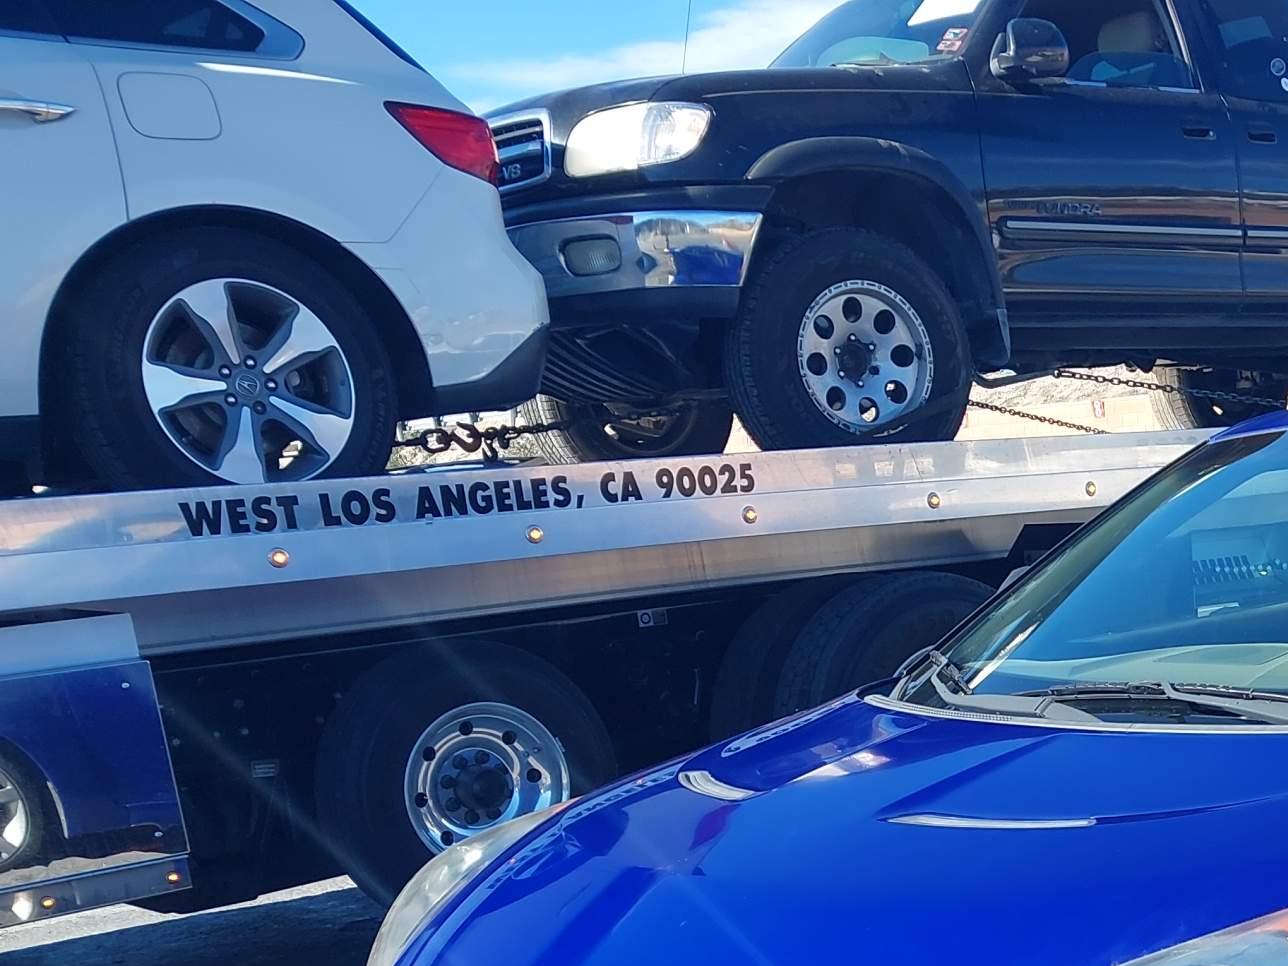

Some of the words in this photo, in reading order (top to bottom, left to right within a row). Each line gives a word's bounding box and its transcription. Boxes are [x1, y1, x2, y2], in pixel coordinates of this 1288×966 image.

[178, 494, 300, 537] WEST
[318, 488, 397, 527] LOS
[415, 475, 585, 519] ANGELES,
[599, 471, 643, 503] CA
[655, 463, 756, 499] 90025
